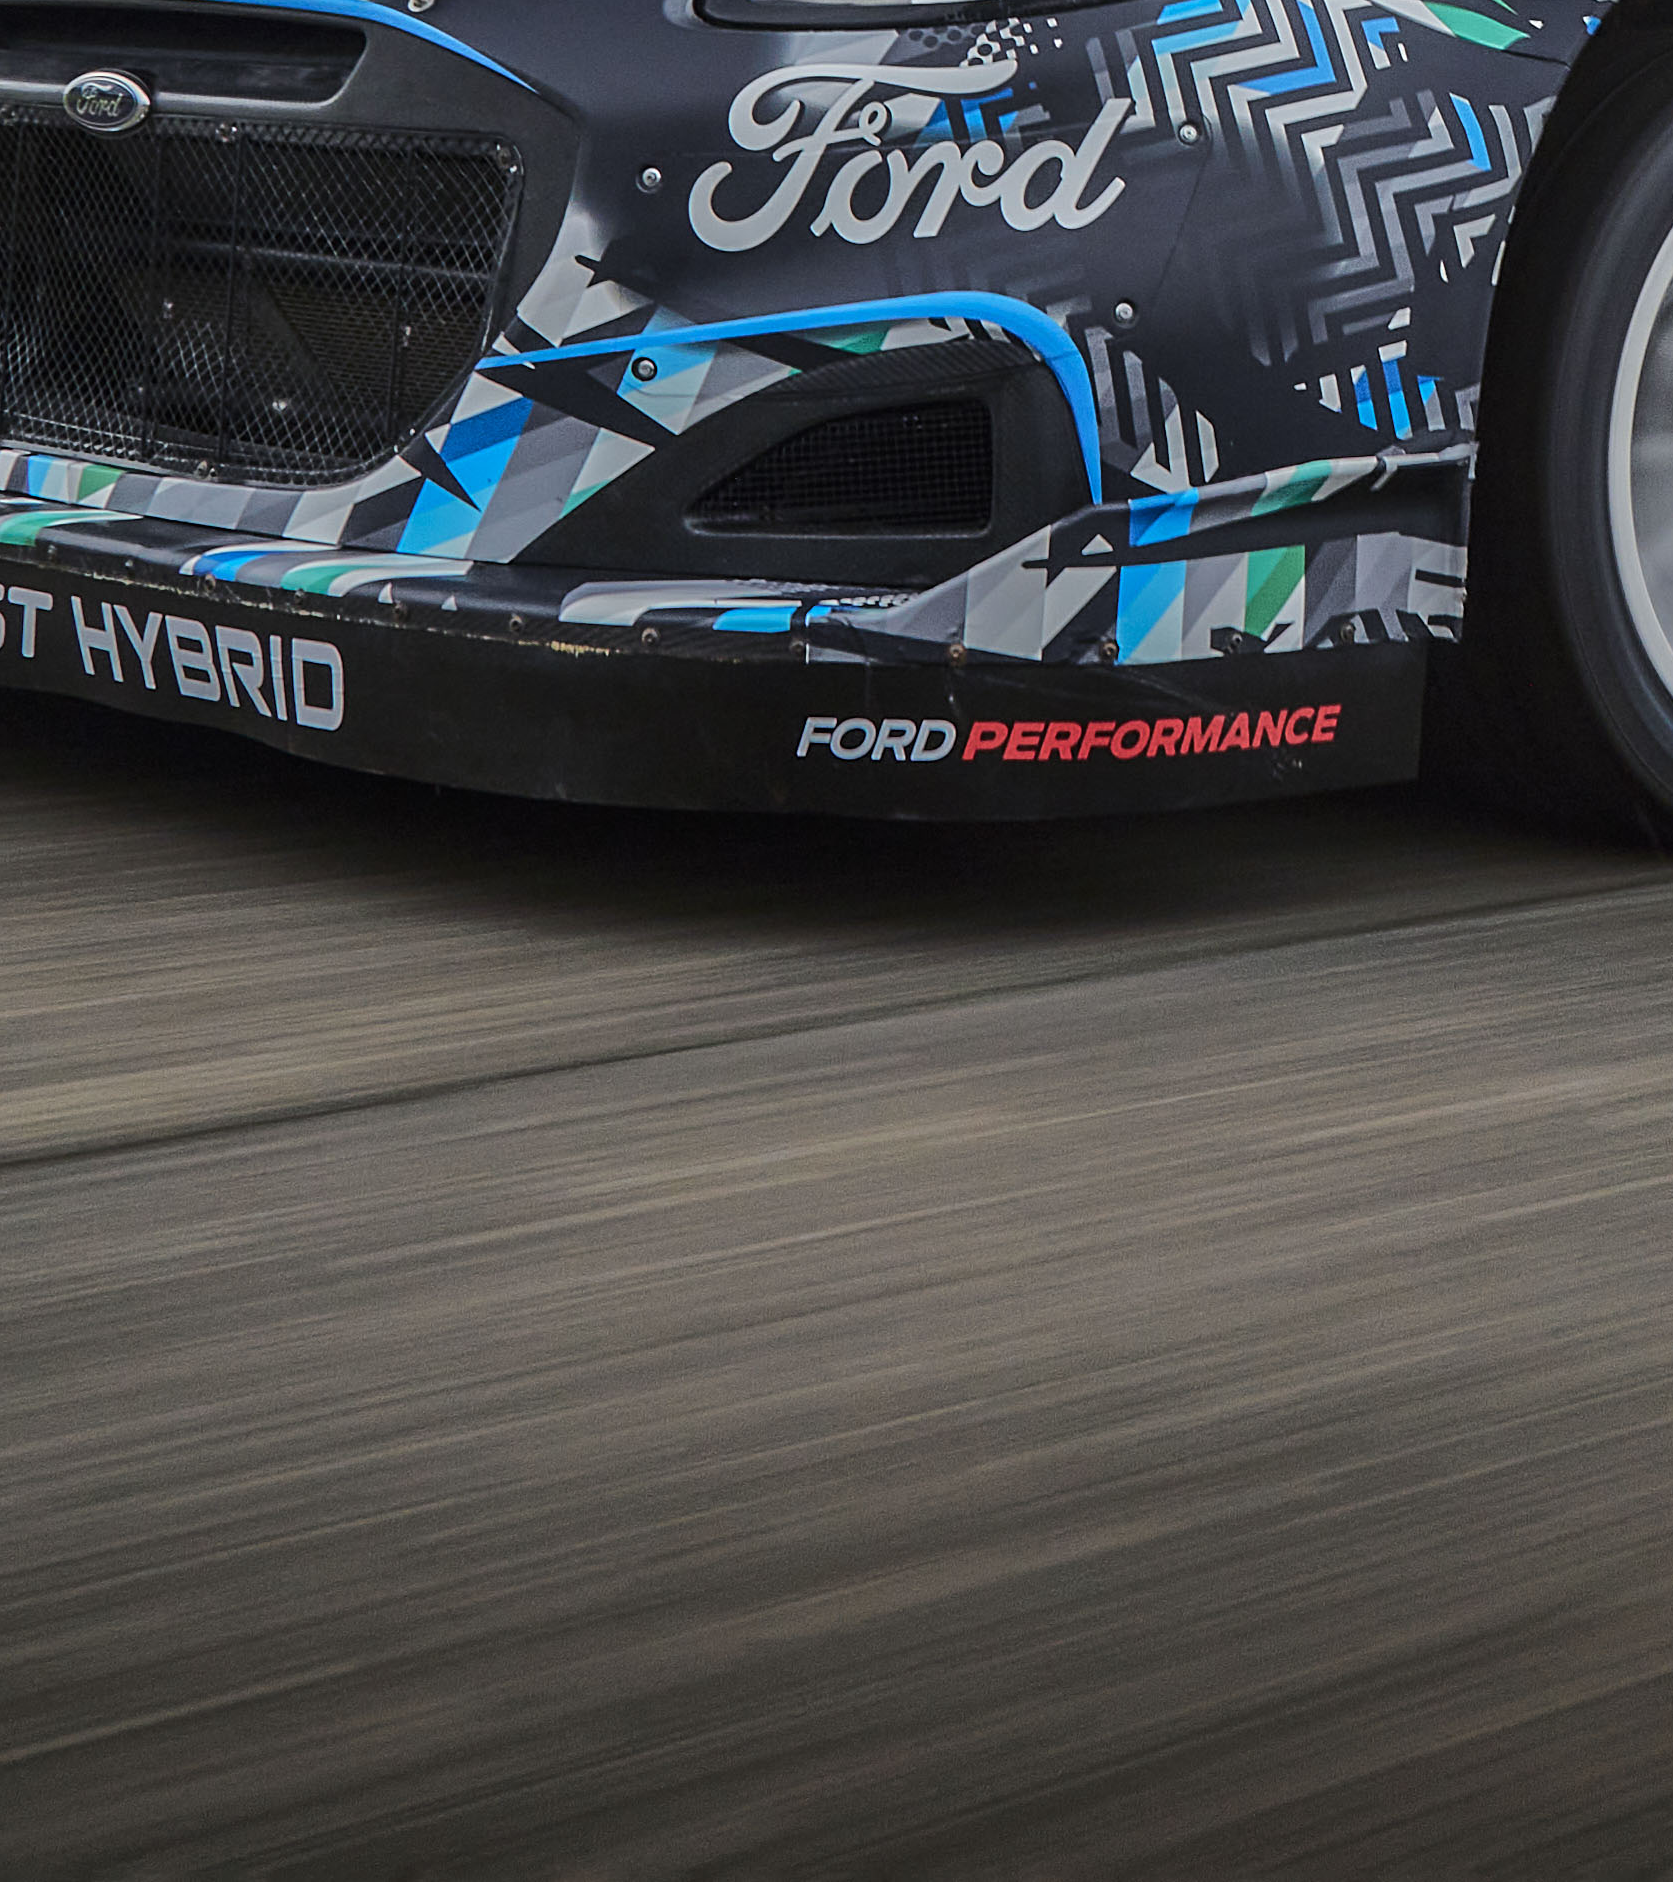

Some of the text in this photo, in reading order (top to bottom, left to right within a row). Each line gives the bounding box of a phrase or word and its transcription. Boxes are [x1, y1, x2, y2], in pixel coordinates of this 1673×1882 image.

[76, 81, 124, 117] Ford
[688, 59, 1132, 252] Ford
[70, 595, 345, 731] HYBRID
[796, 704, 1342, 761] FORD PERFORMANCE
